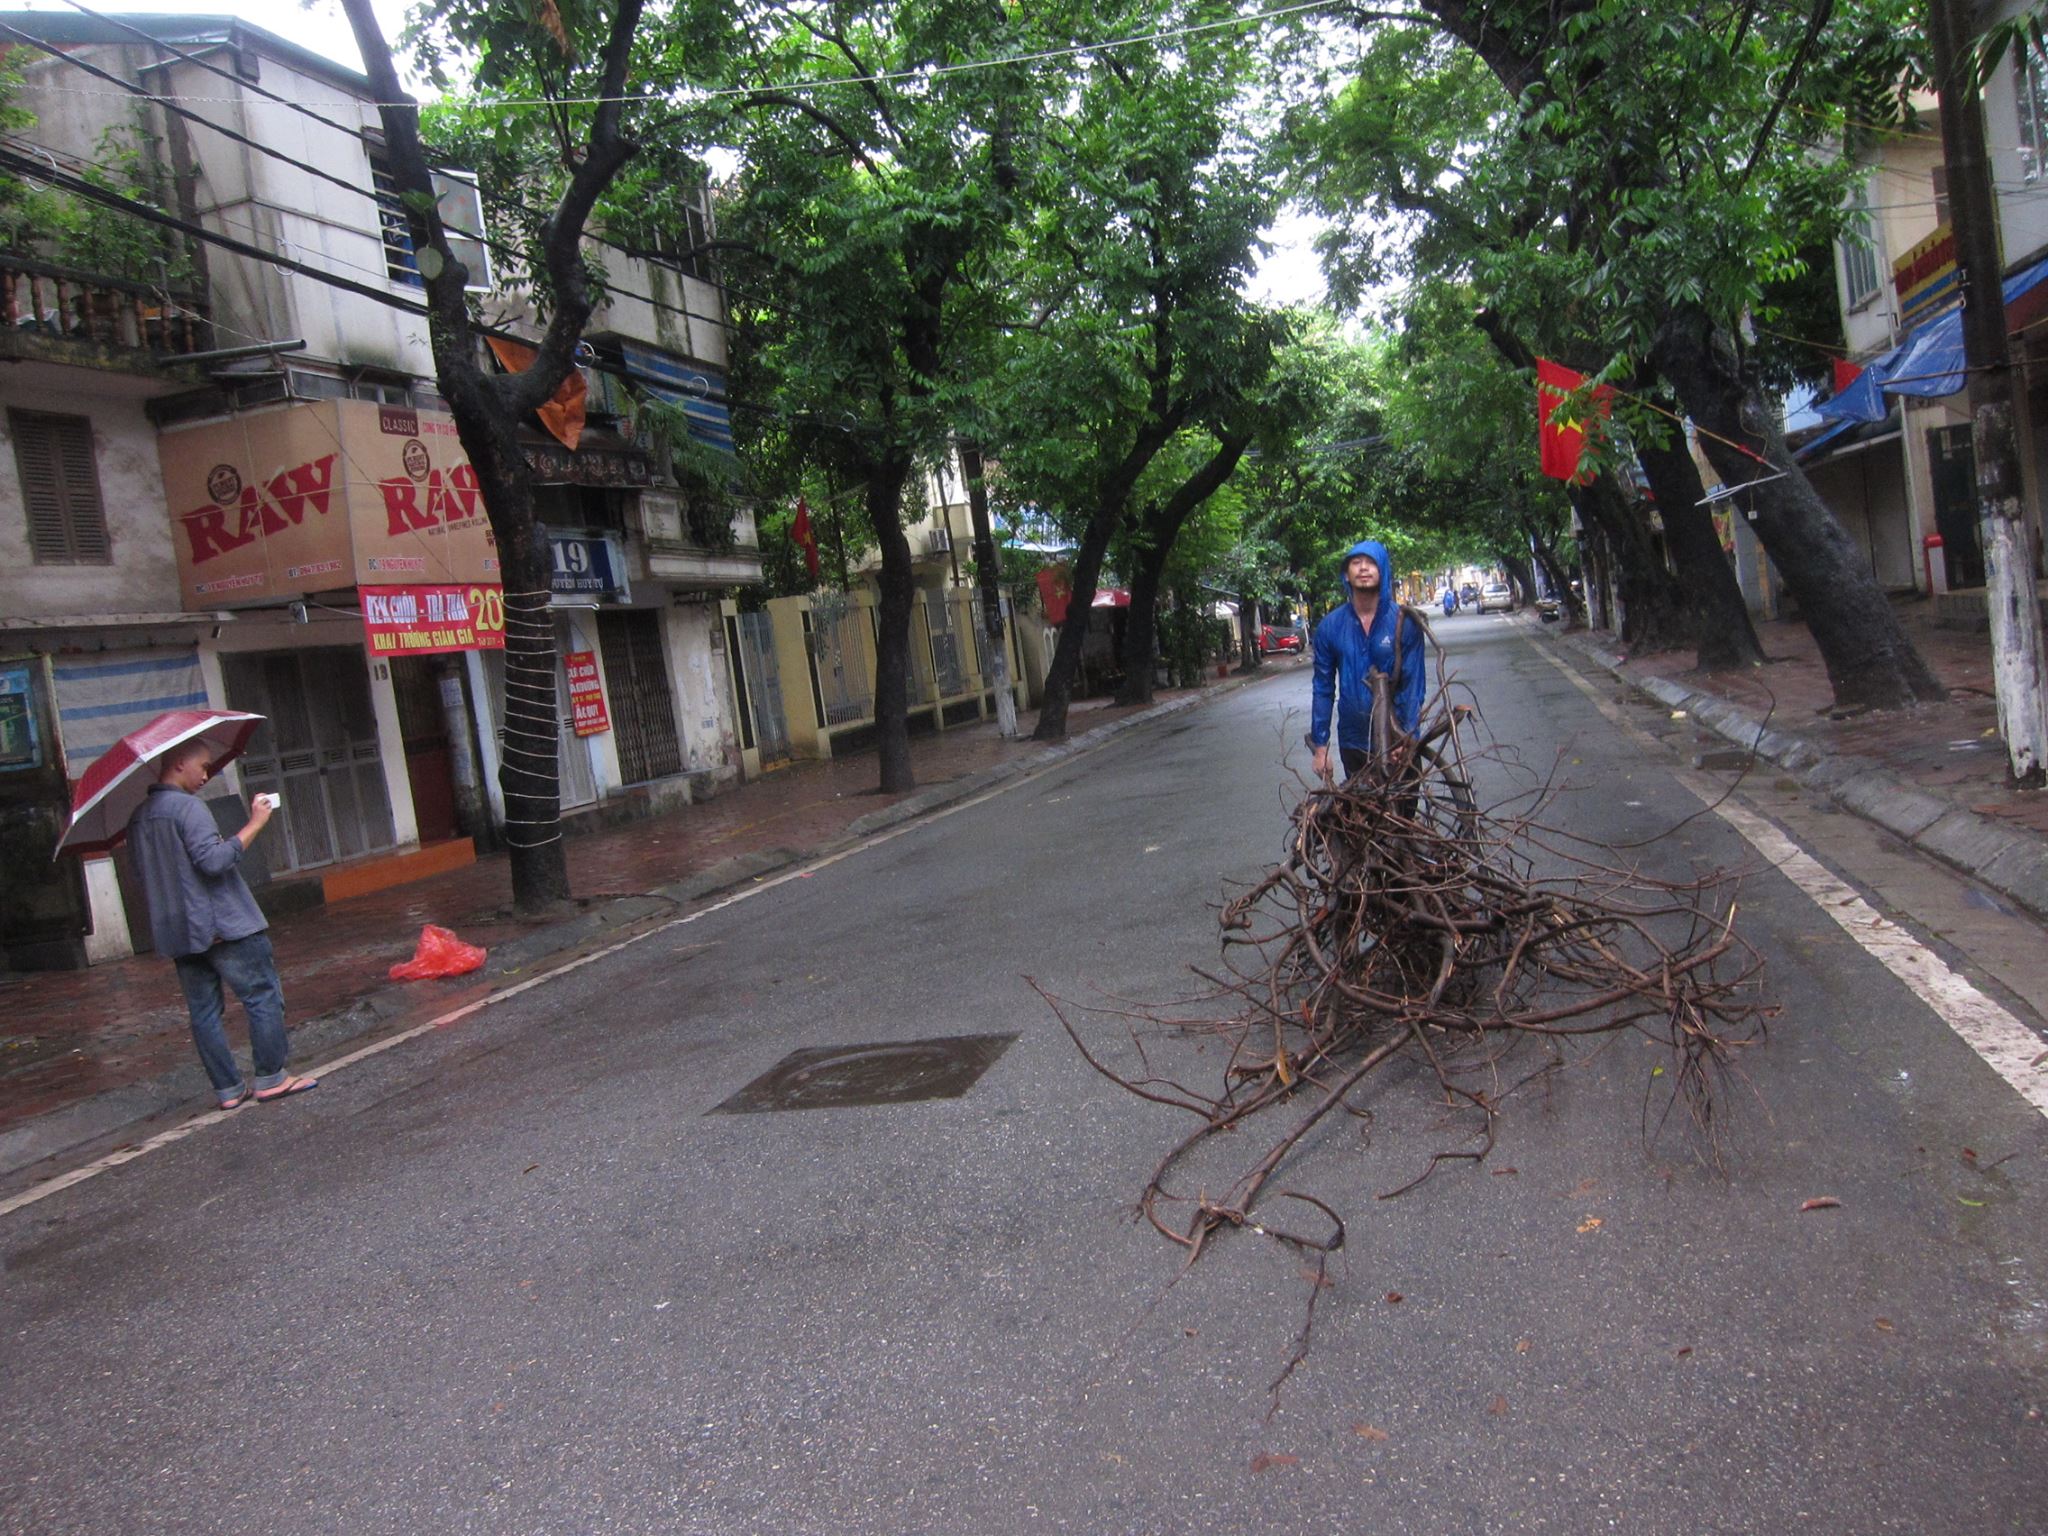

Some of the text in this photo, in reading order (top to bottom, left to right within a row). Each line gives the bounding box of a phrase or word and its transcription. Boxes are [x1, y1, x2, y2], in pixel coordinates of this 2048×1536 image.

[382, 416, 416, 434] CLASSIC
[177, 453, 335, 565] RAW
[550, 541, 588, 573] 19
[425, 590, 445, 623] TRÀ
[446, 589, 470, 622] THÁI
[470, 588, 506, 631] 20
[372, 632, 397, 651] KHAI
[456, 627, 475, 646] GIÁ
